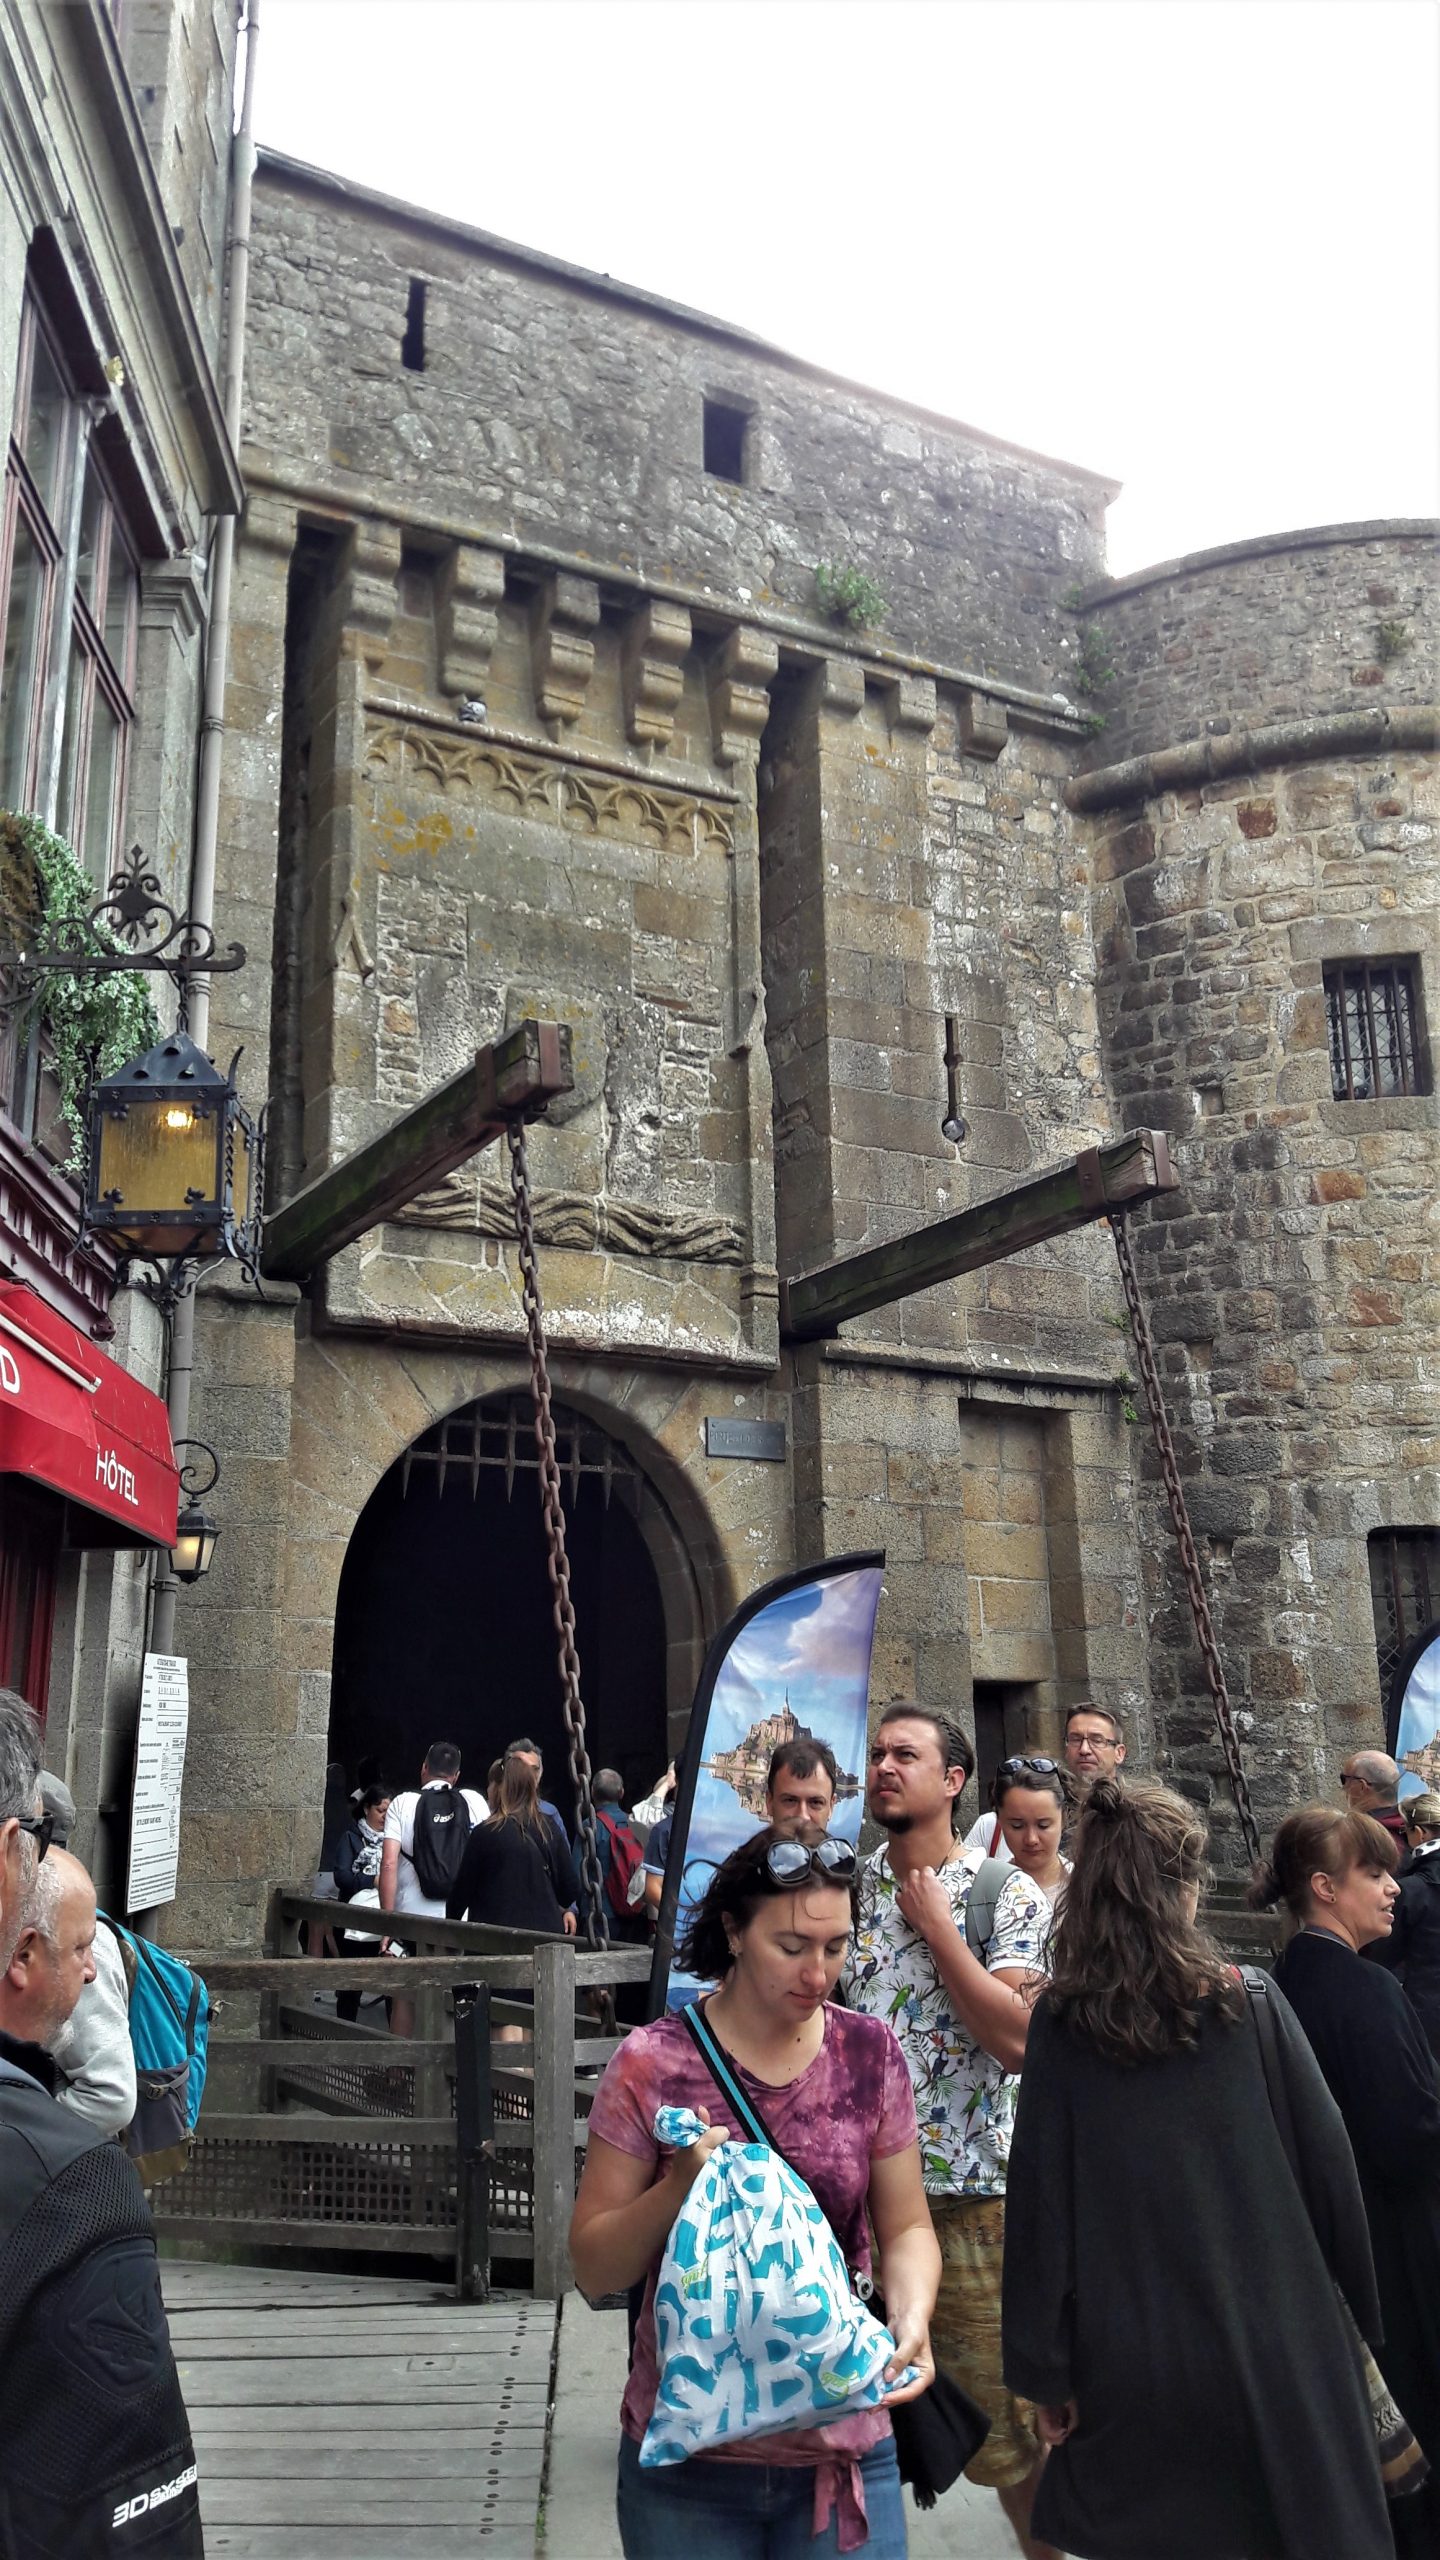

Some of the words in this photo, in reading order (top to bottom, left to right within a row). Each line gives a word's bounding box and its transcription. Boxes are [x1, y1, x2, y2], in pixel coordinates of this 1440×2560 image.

[96, 1449, 139, 1506] HÔTEL
[439, 1811, 455, 1823] asics
[112, 2493, 149, 2528] 3D
